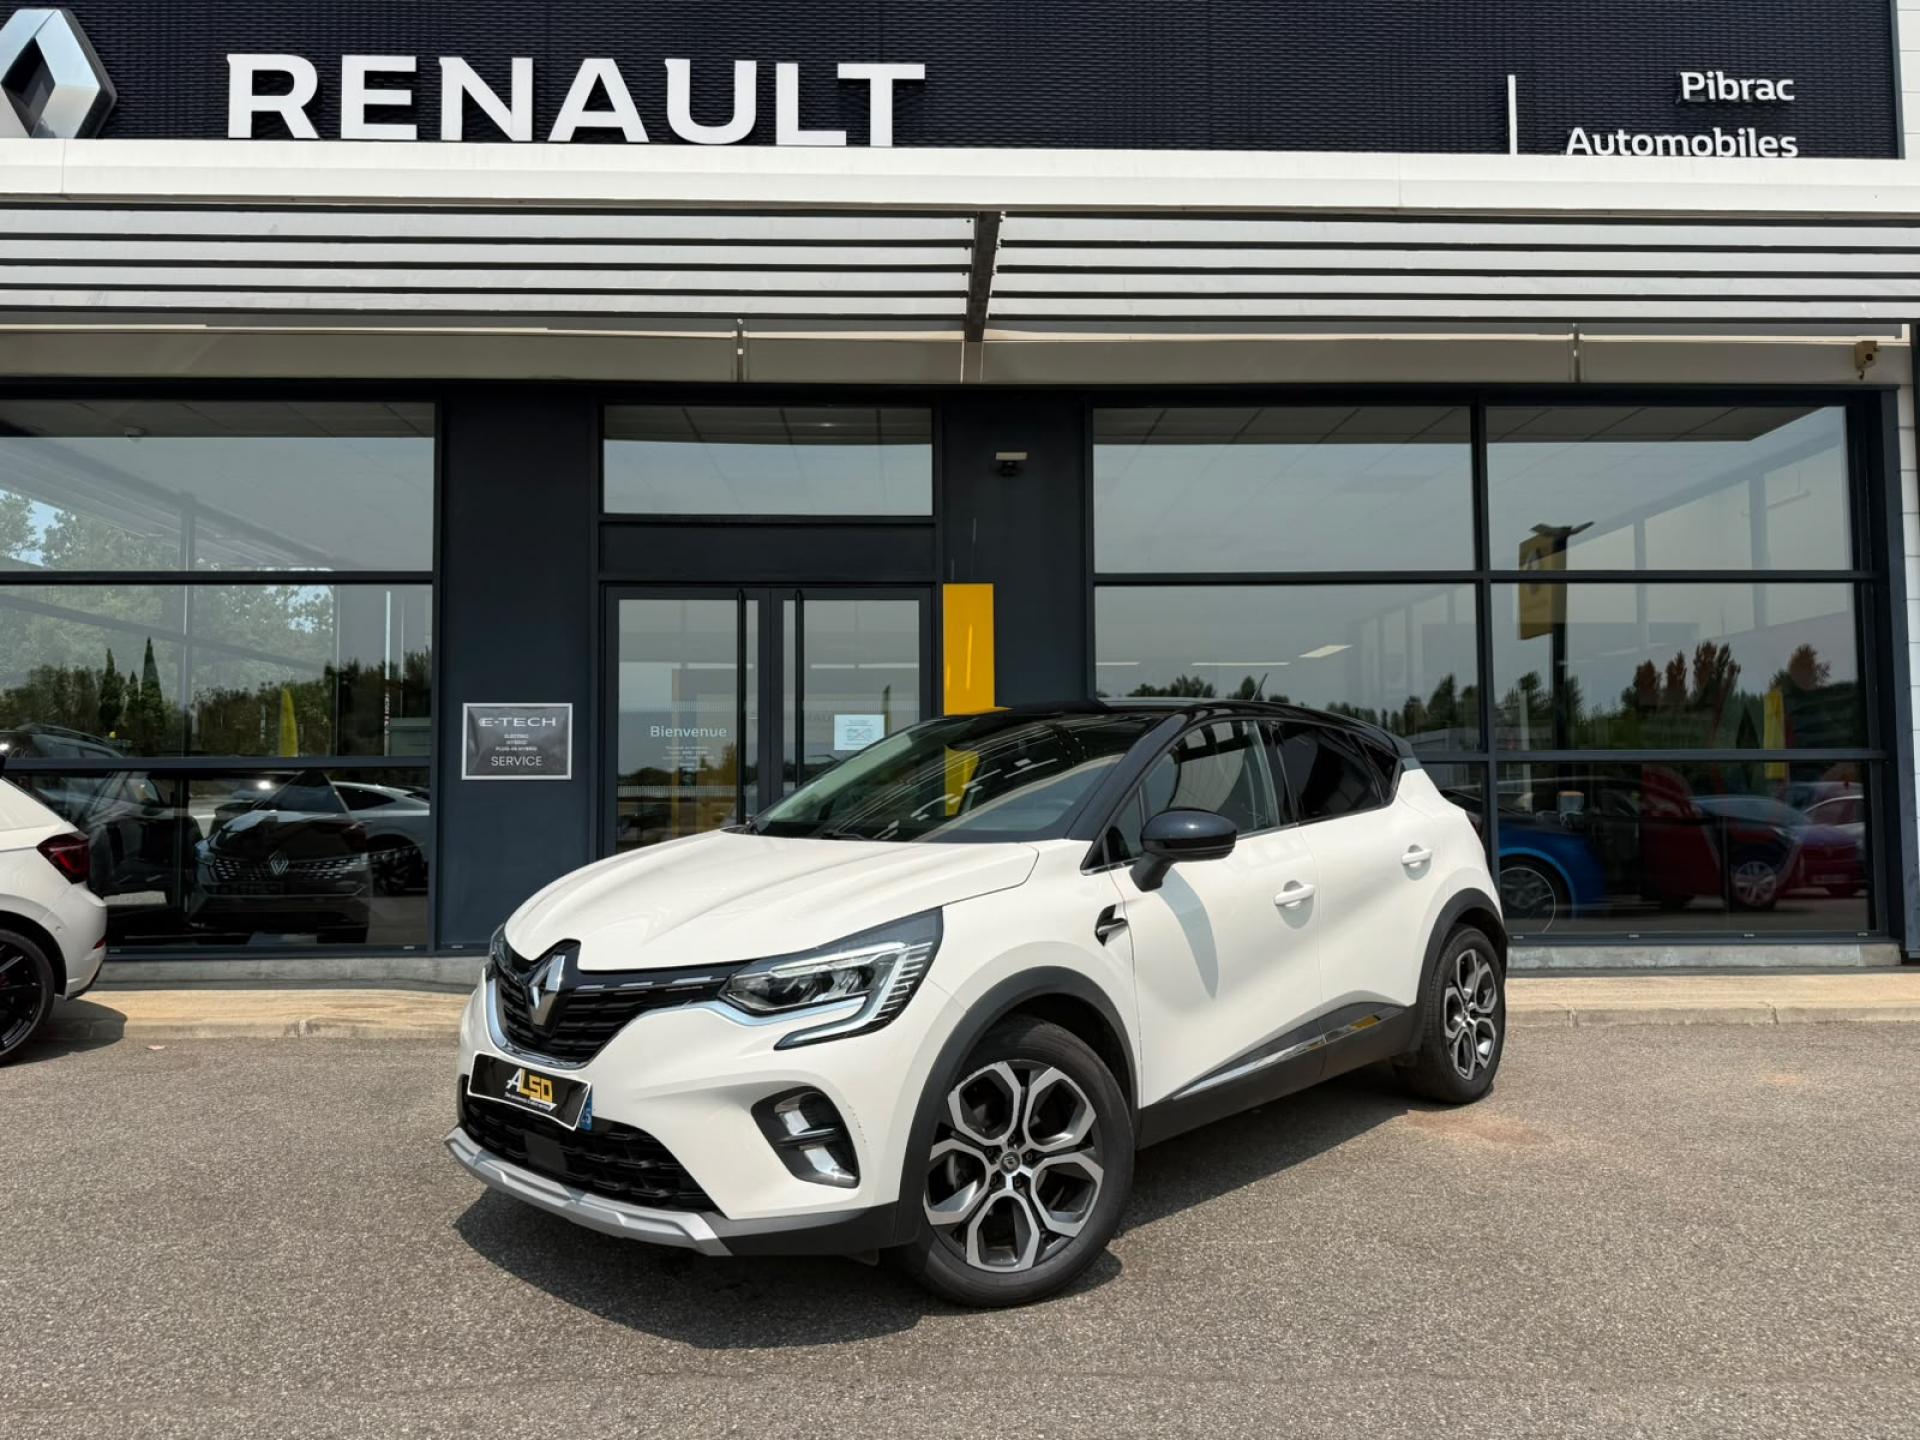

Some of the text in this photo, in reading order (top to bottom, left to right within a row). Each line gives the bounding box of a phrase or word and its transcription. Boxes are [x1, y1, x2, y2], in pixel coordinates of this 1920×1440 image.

[1680, 71, 1795, 101] Pibrac
[226, 53, 926, 147] RENAULT
[1565, 126, 1799, 157] Automobiles
[479, 717, 557, 727] E-TECH
[650, 725, 727, 738] Bienvenue
[491, 756, 543, 767] SERVICE
